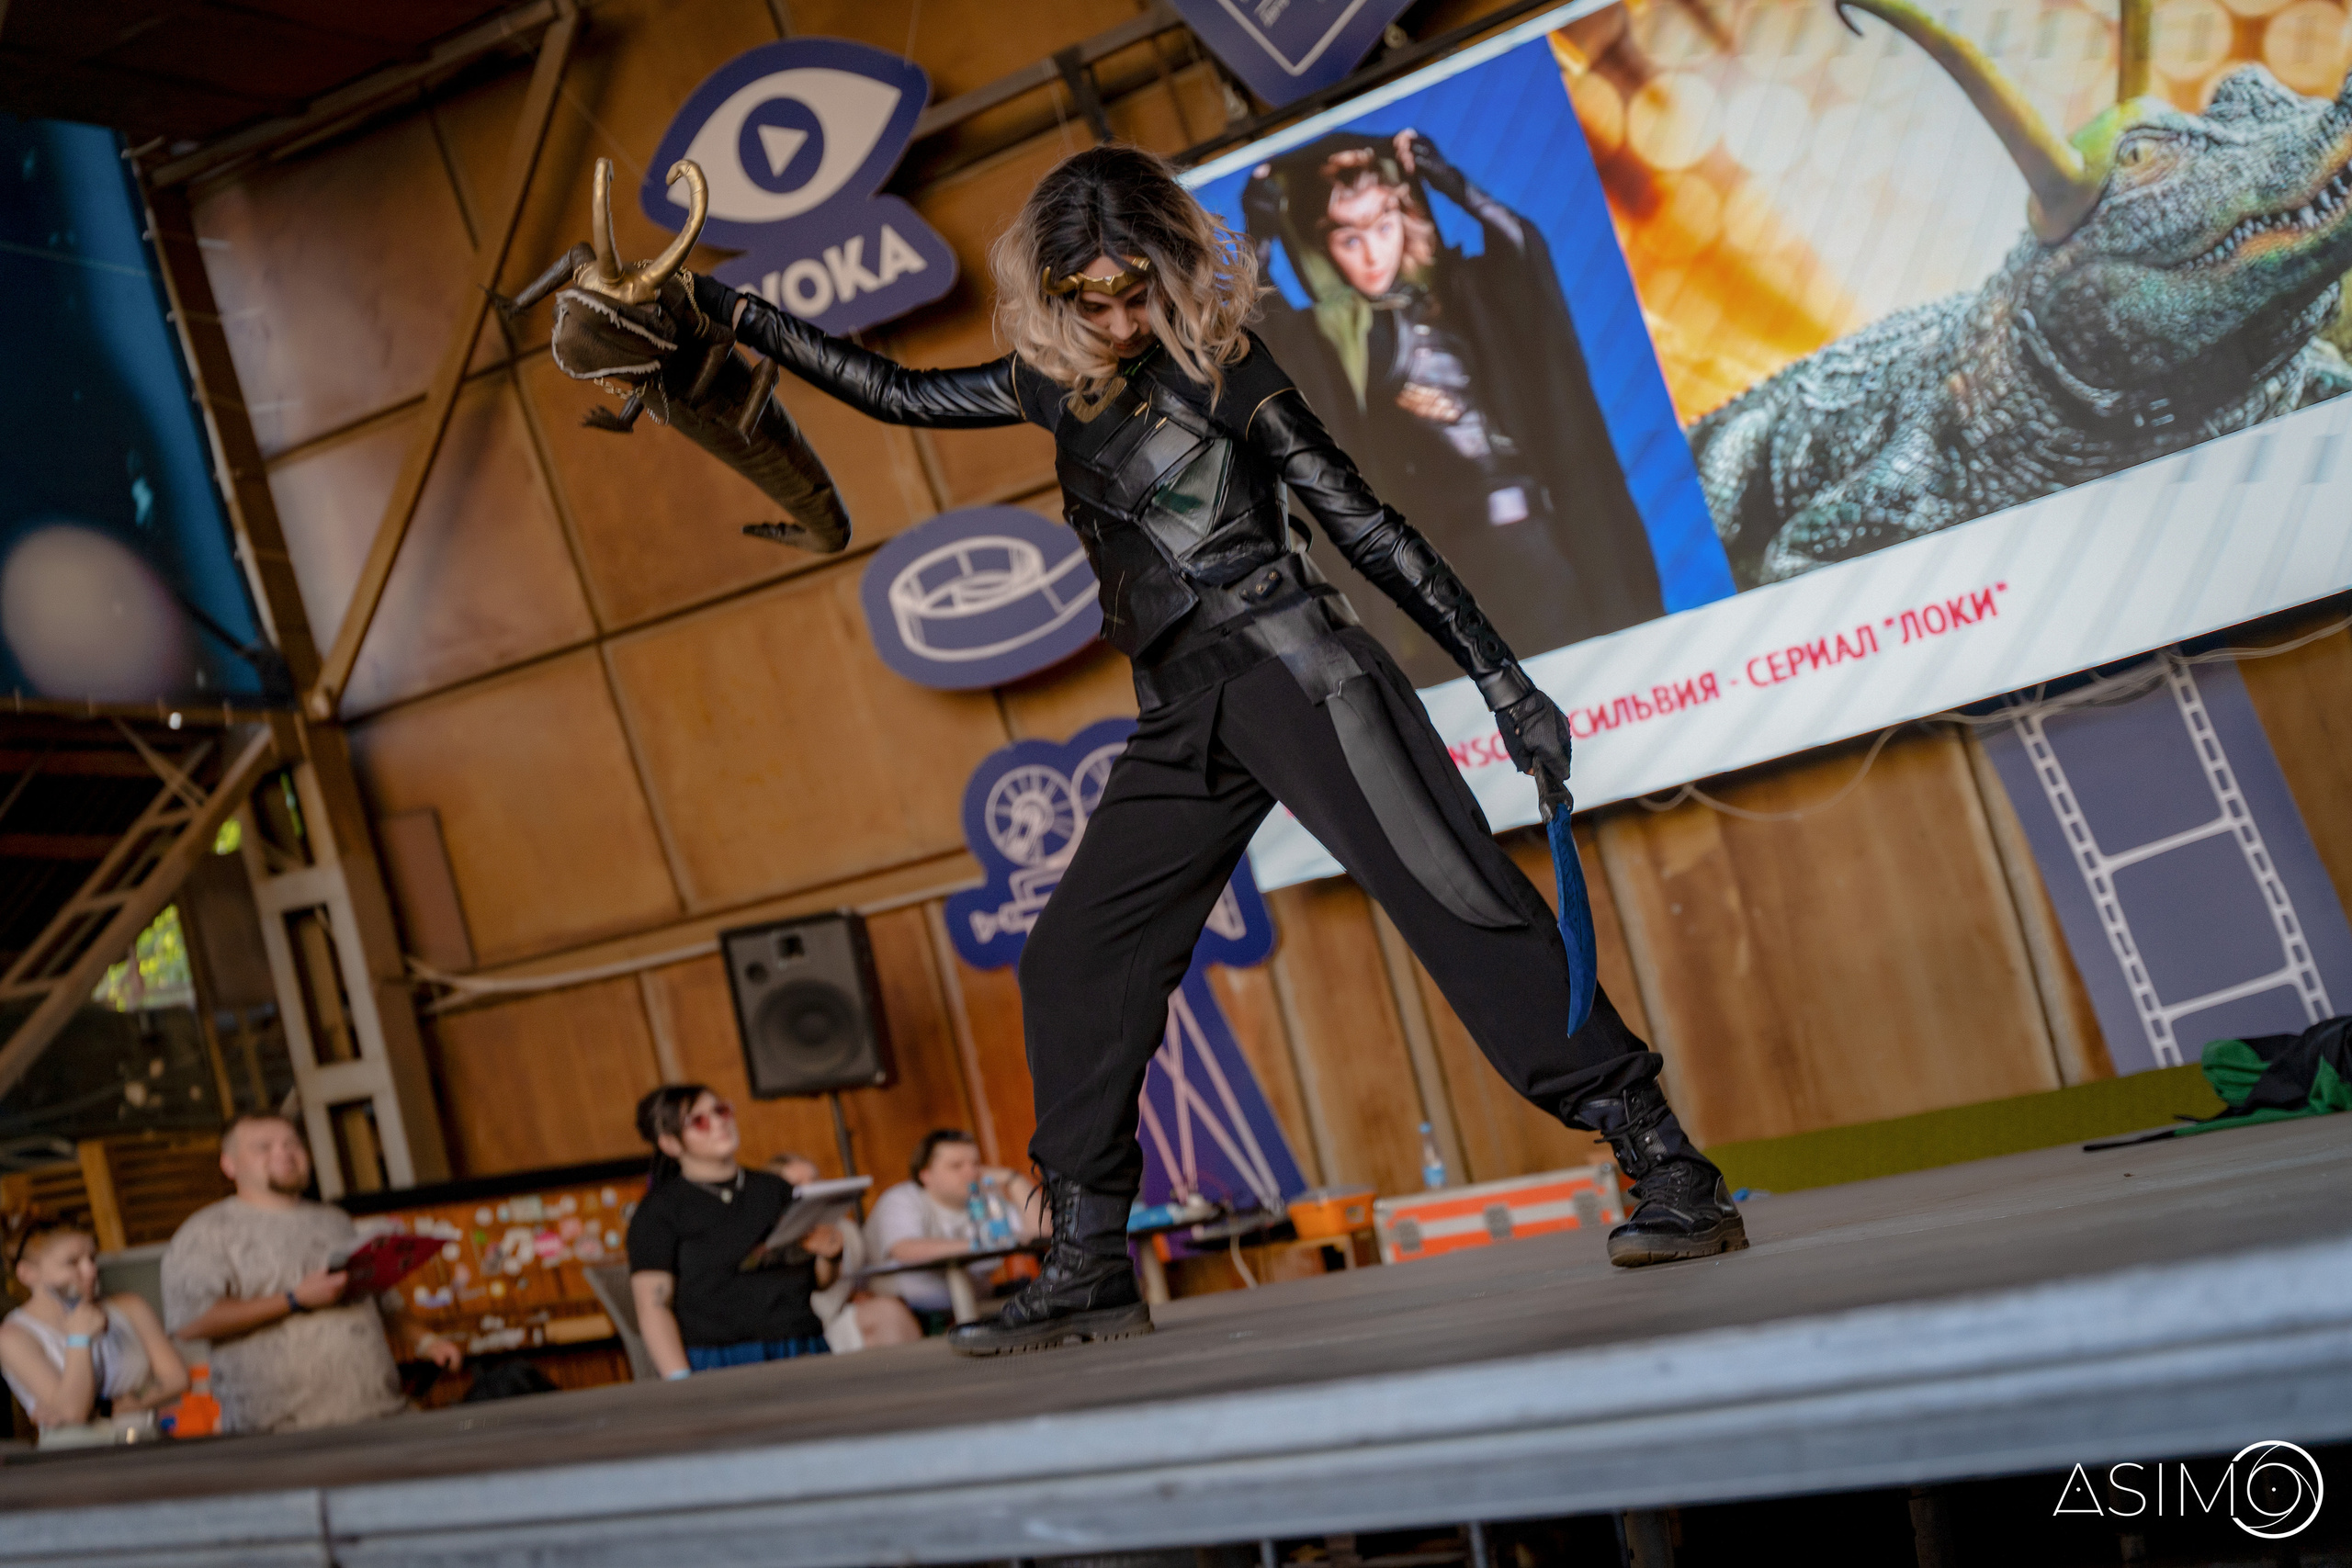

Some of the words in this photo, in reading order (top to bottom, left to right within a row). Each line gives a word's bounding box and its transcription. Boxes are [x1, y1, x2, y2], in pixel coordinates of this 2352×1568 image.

[1568, 671, 1721, 739] СИЛЬВИЯ
[1747, 625, 1880, 687] СЕРИАЛ
[1883, 581, 2008, 644] "ЛОКИ"
